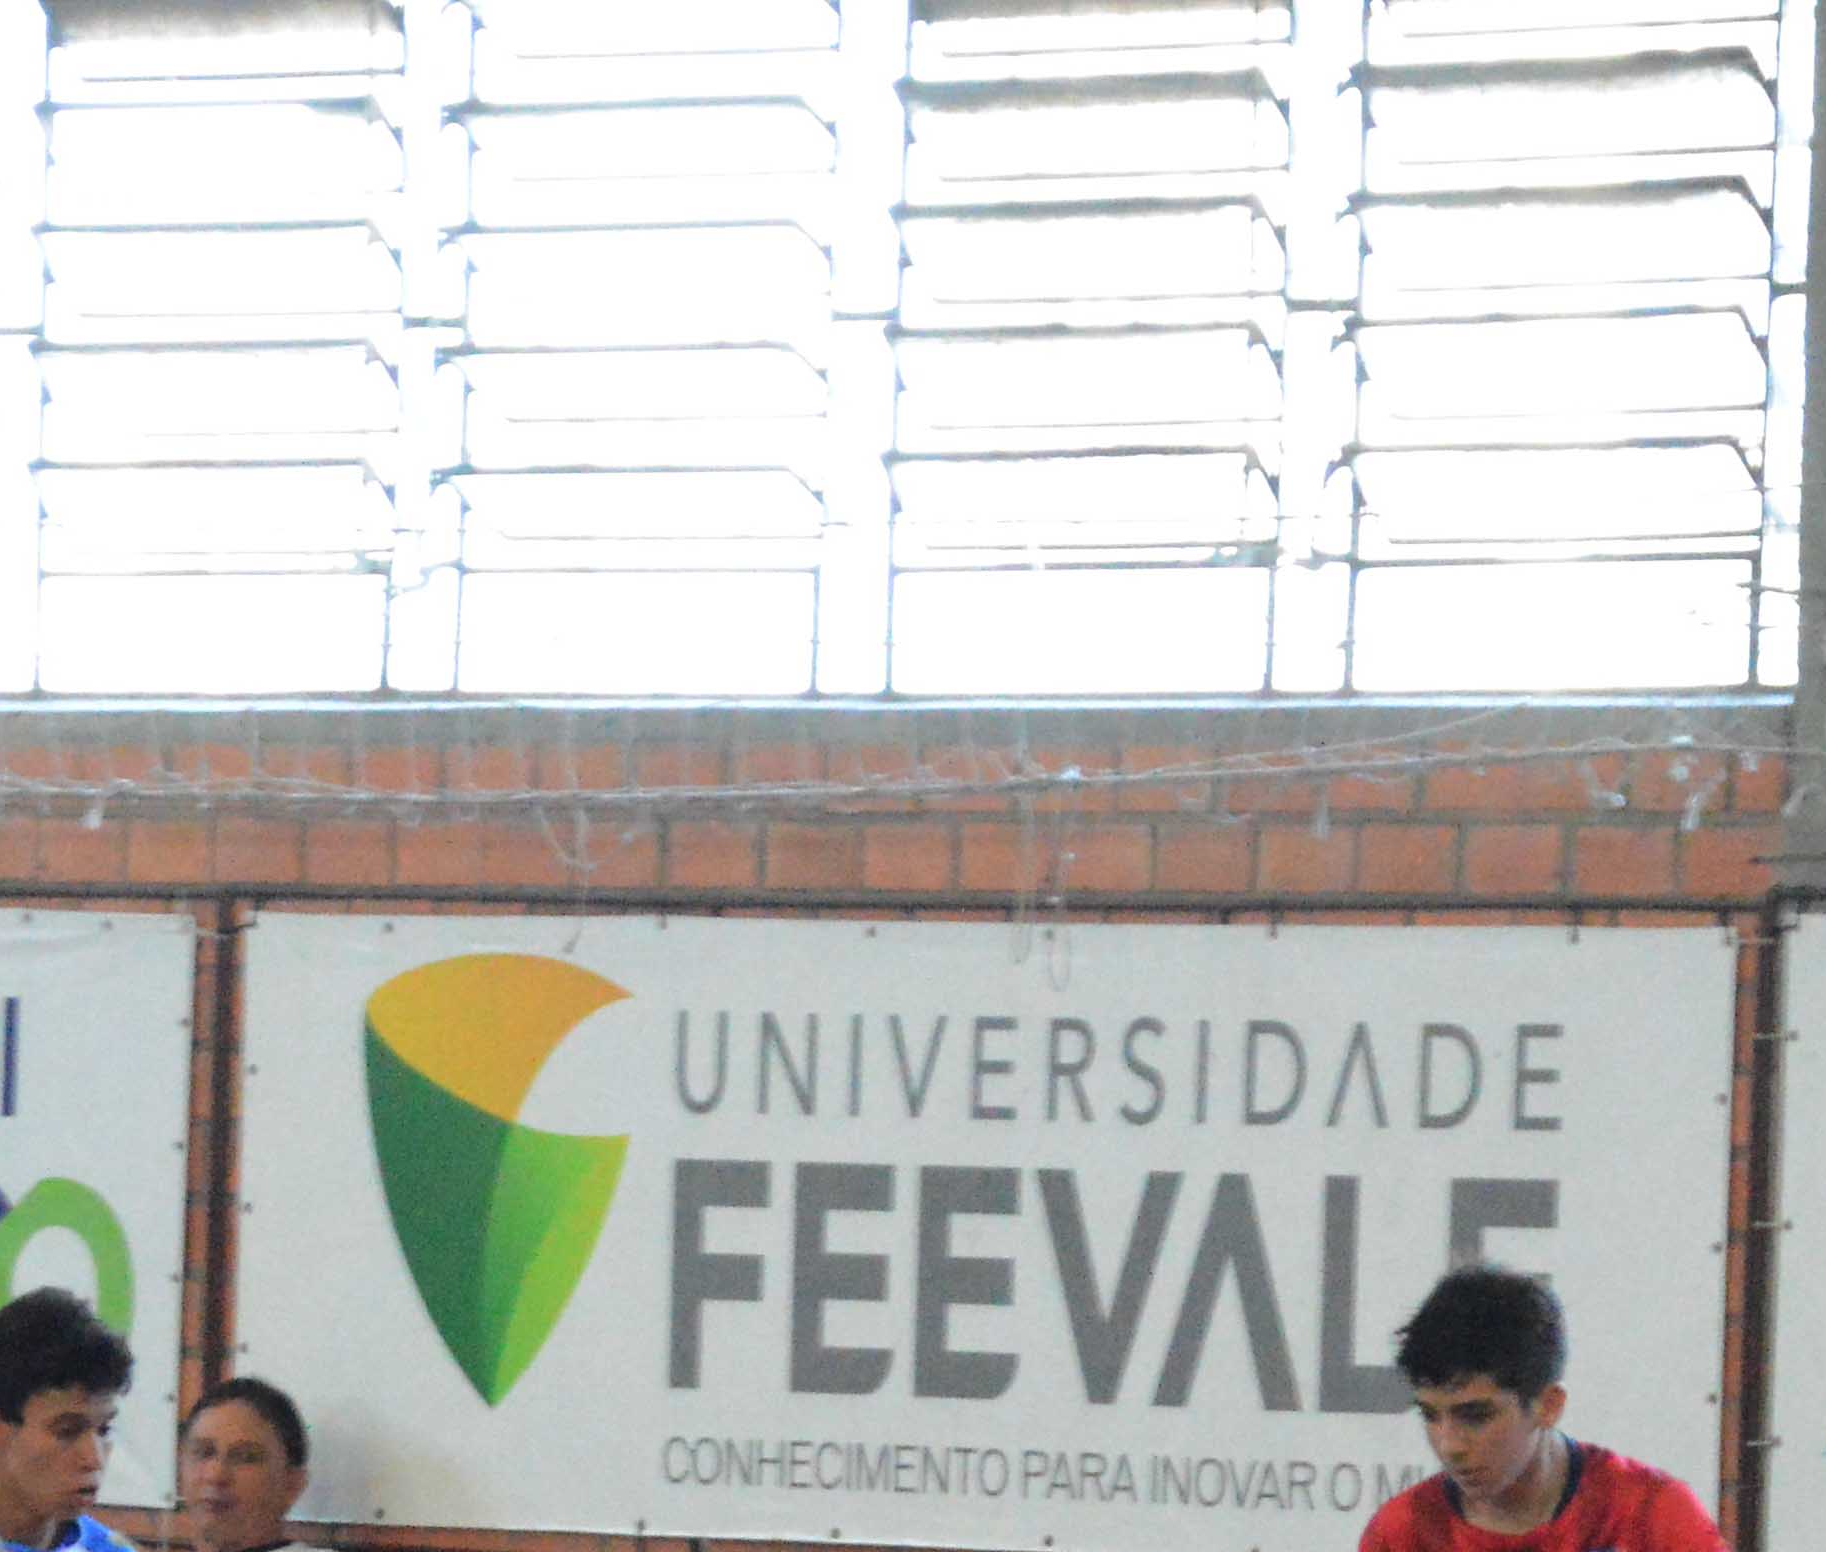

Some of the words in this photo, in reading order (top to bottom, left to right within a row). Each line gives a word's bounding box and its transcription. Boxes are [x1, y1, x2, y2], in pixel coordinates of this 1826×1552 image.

[675, 1010, 1564, 1131] UNIVERSIDADE
[662, 1435, 1009, 1497] CONHECIMENTO
[1021, 1449, 1137, 1503] PARA
[1150, 1455, 1316, 1511] INOVAR
[1330, 1462, 1363, 1511] O
